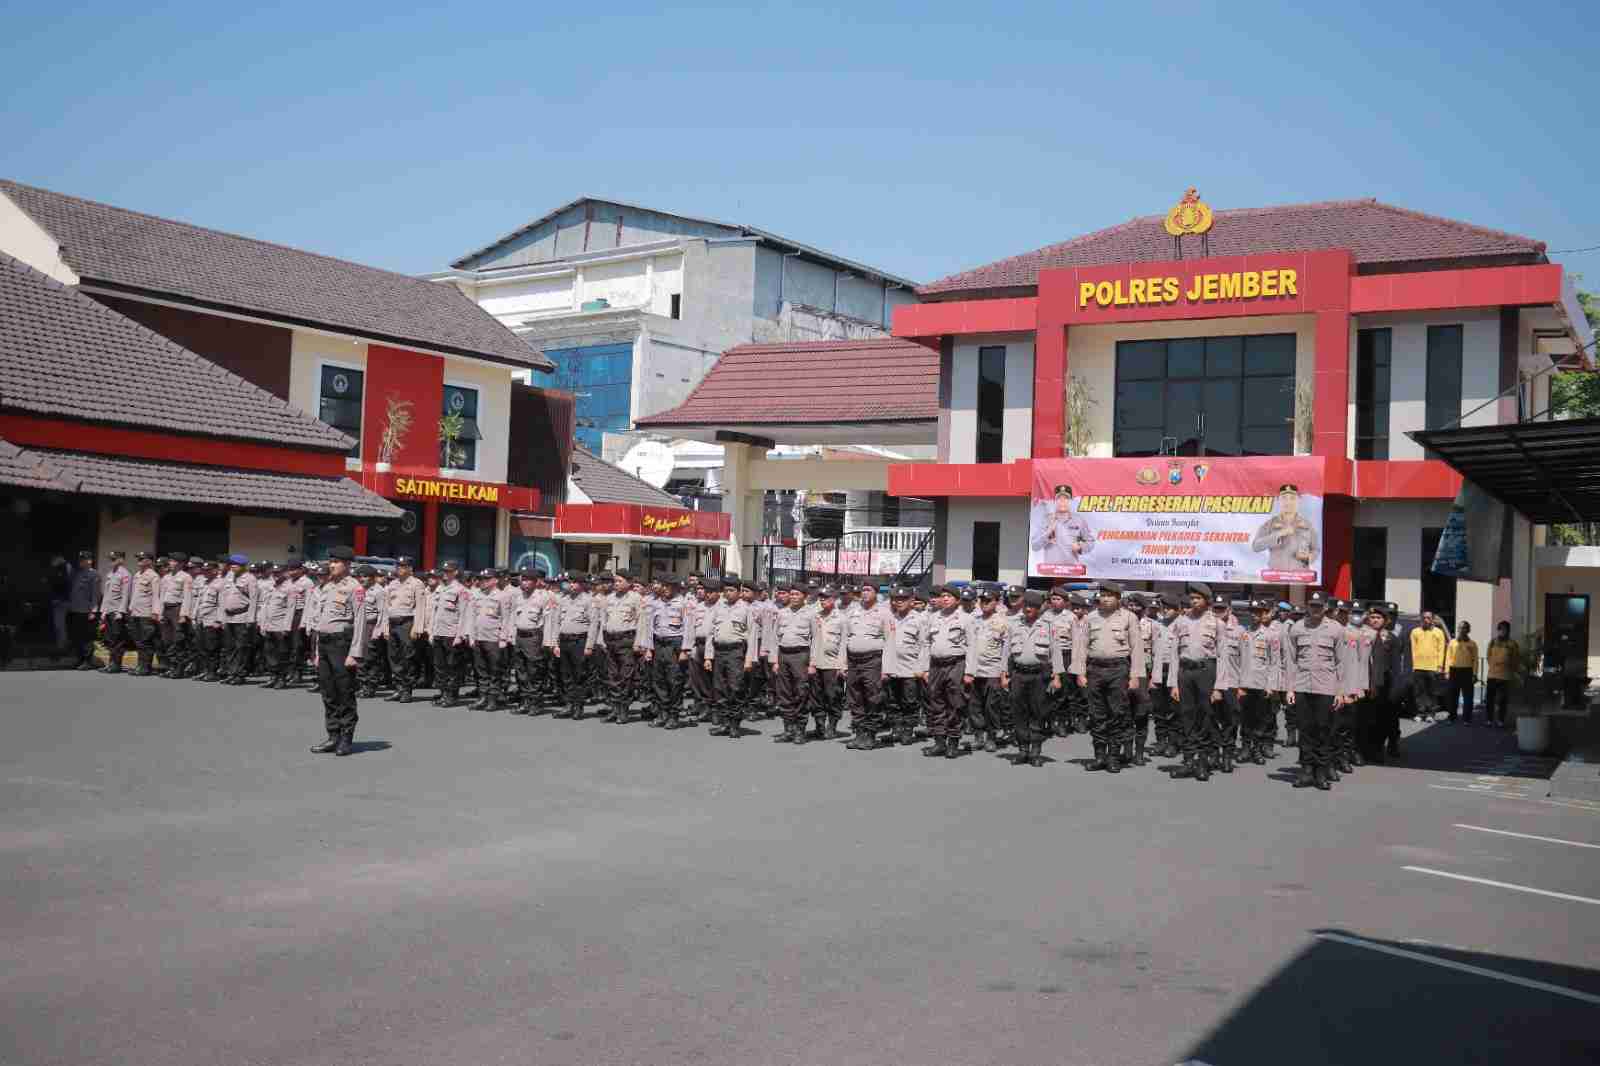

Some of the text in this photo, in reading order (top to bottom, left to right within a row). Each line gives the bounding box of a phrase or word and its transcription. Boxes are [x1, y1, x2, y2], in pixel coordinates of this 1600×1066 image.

[1079, 269, 1298, 307] POLRES JEMBER
[395, 478, 499, 502] SATINTELKAM
[1077, 495, 1274, 513] APEL PERGESERAN PASUKAN
[1140, 544, 1169, 555] TAHUN
[1120, 557, 1153, 566] WILAYAH
[1155, 558, 1200, 567] KABUPATEN
[1201, 559, 1234, 567] JEMBER
